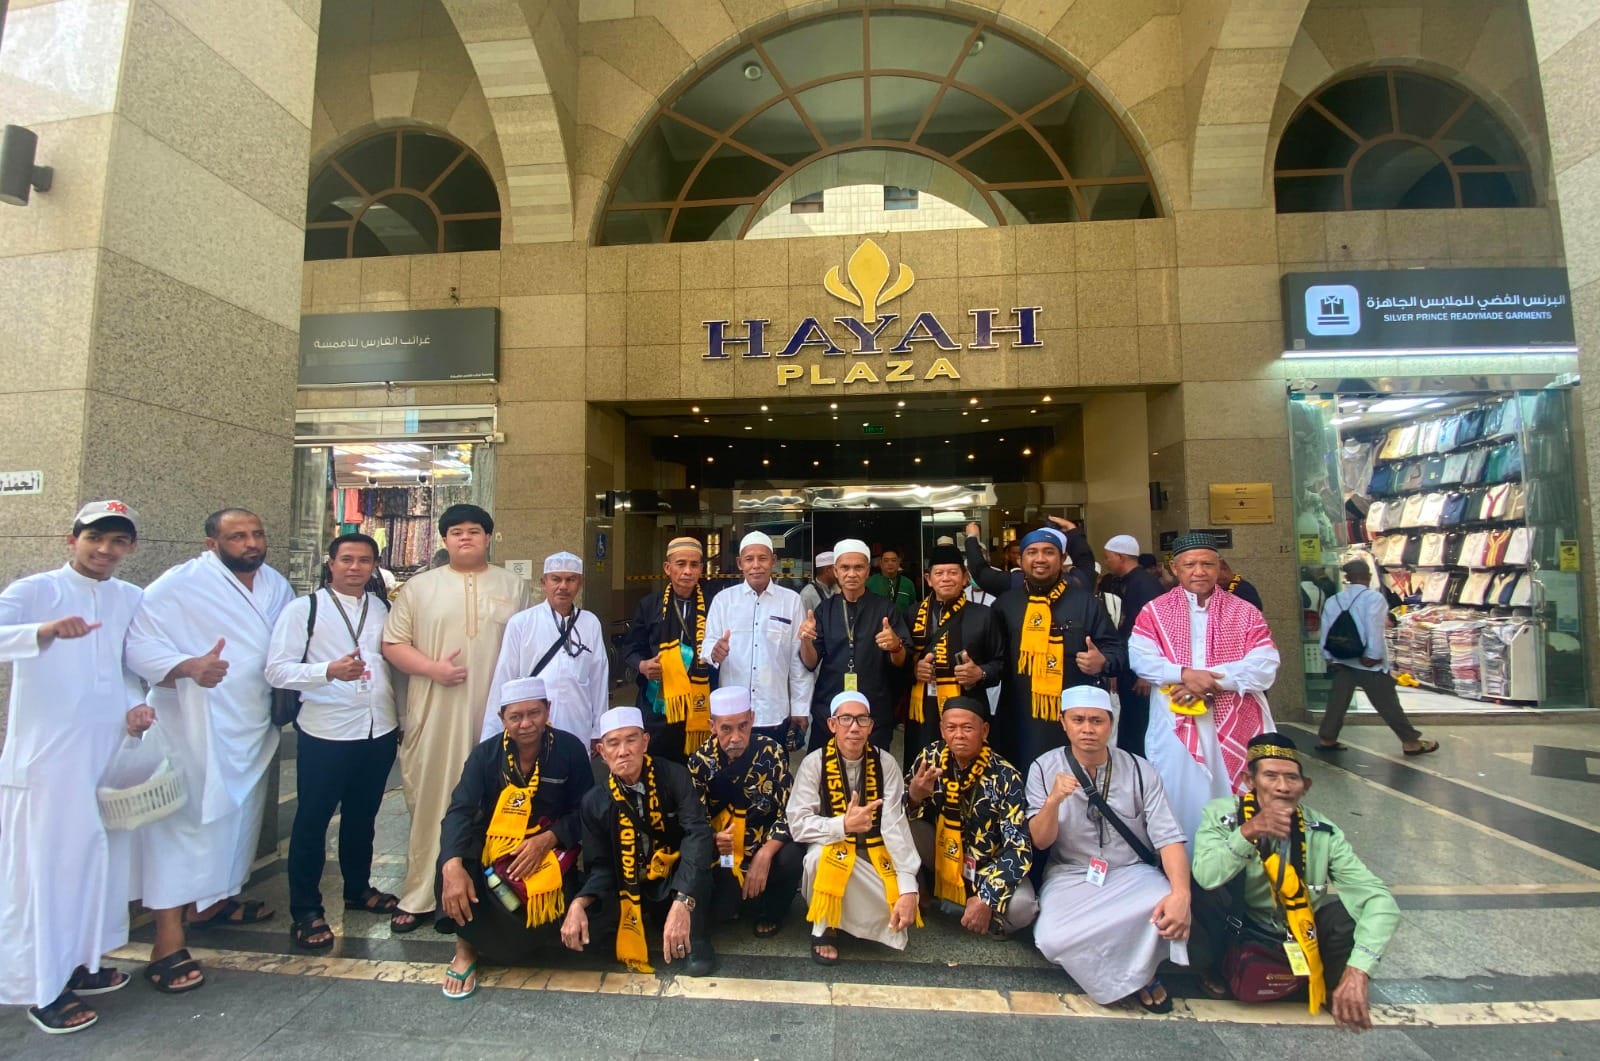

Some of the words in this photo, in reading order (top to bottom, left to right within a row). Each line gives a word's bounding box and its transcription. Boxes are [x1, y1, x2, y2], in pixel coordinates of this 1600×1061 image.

[1366, 296, 1417, 310] الجاهزة
[1420, 295, 1474, 309] للملابس
[1477, 294, 1520, 311] الفضي
[1384, 313, 1414, 322] SILVER
[1416, 312, 1448, 321] PRINCE
[1450, 311, 1504, 321] READYMADE
[1505, 311, 1552, 320] GARMENTS
[702, 306, 1043, 359] HAYAH
[777, 358, 961, 386] PLAZA
[619, 812, 637, 879] HOLIDA
